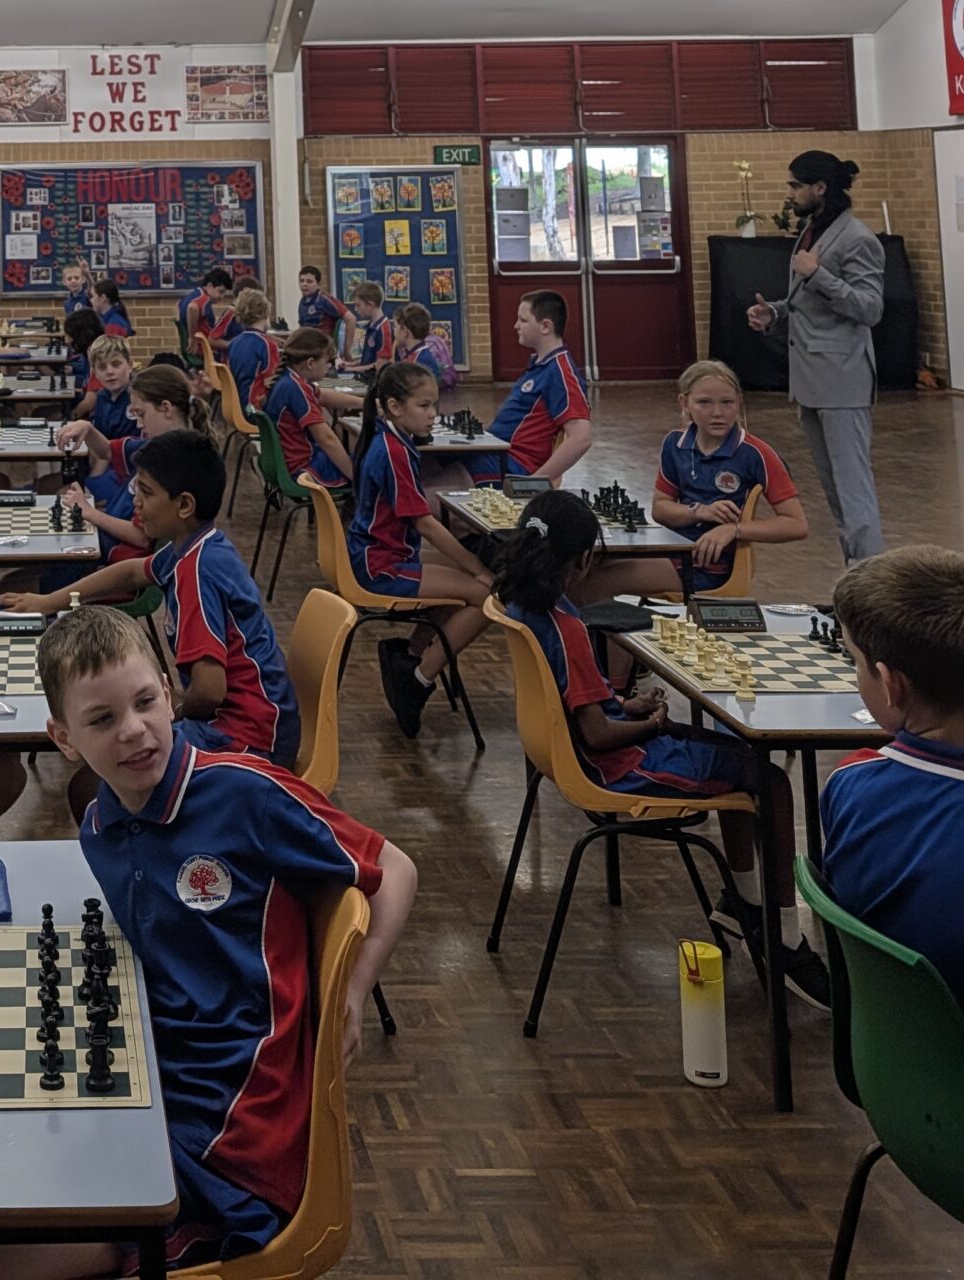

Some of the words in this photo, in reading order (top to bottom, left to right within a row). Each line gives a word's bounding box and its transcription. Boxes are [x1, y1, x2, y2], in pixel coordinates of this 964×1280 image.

[90, 54, 161, 76] LEST
[106, 82, 147, 103] WE
[72, 110, 182, 133] FORGET
[442, 148, 472, 162] EXIT
[77, 168, 182, 202] HONOUR
